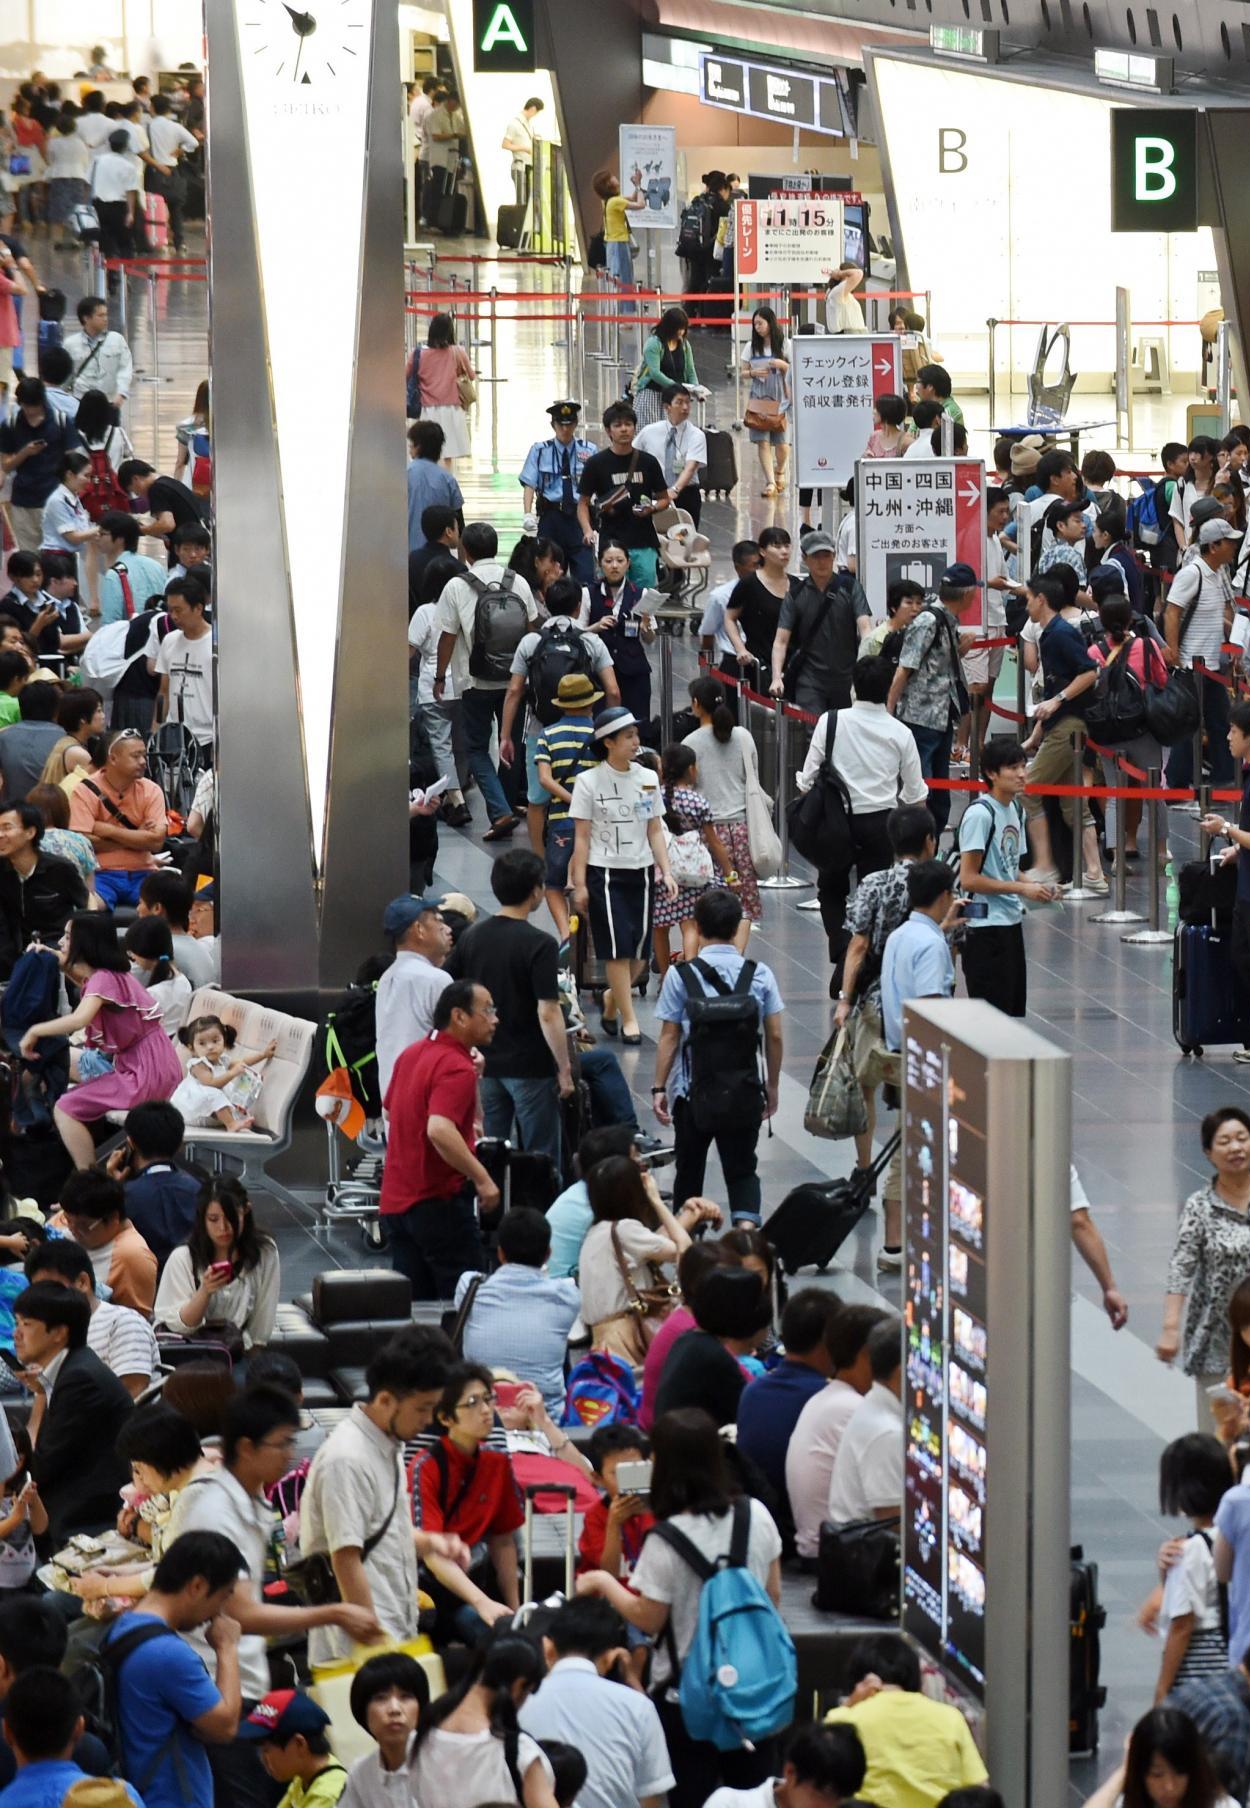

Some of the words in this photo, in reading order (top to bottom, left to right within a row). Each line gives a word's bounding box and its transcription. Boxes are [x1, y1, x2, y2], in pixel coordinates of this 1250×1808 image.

[481, 3, 528, 52] A
[938, 127, 968, 174] B
[1135, 137, 1176, 201] B
[741, 203, 752, 257] 優先レーン
[802, 355, 871, 370] チェックイン
[802, 374, 870, 389] マイル登録
[803, 394, 872, 409] 領収書発行
[865, 472, 953, 491] 中国・四国
[865, 497, 954, 517] 九州・沖縄
[894, 524, 925, 534] 方面へ
[871, 538, 949, 550] ご出発のお客さま
